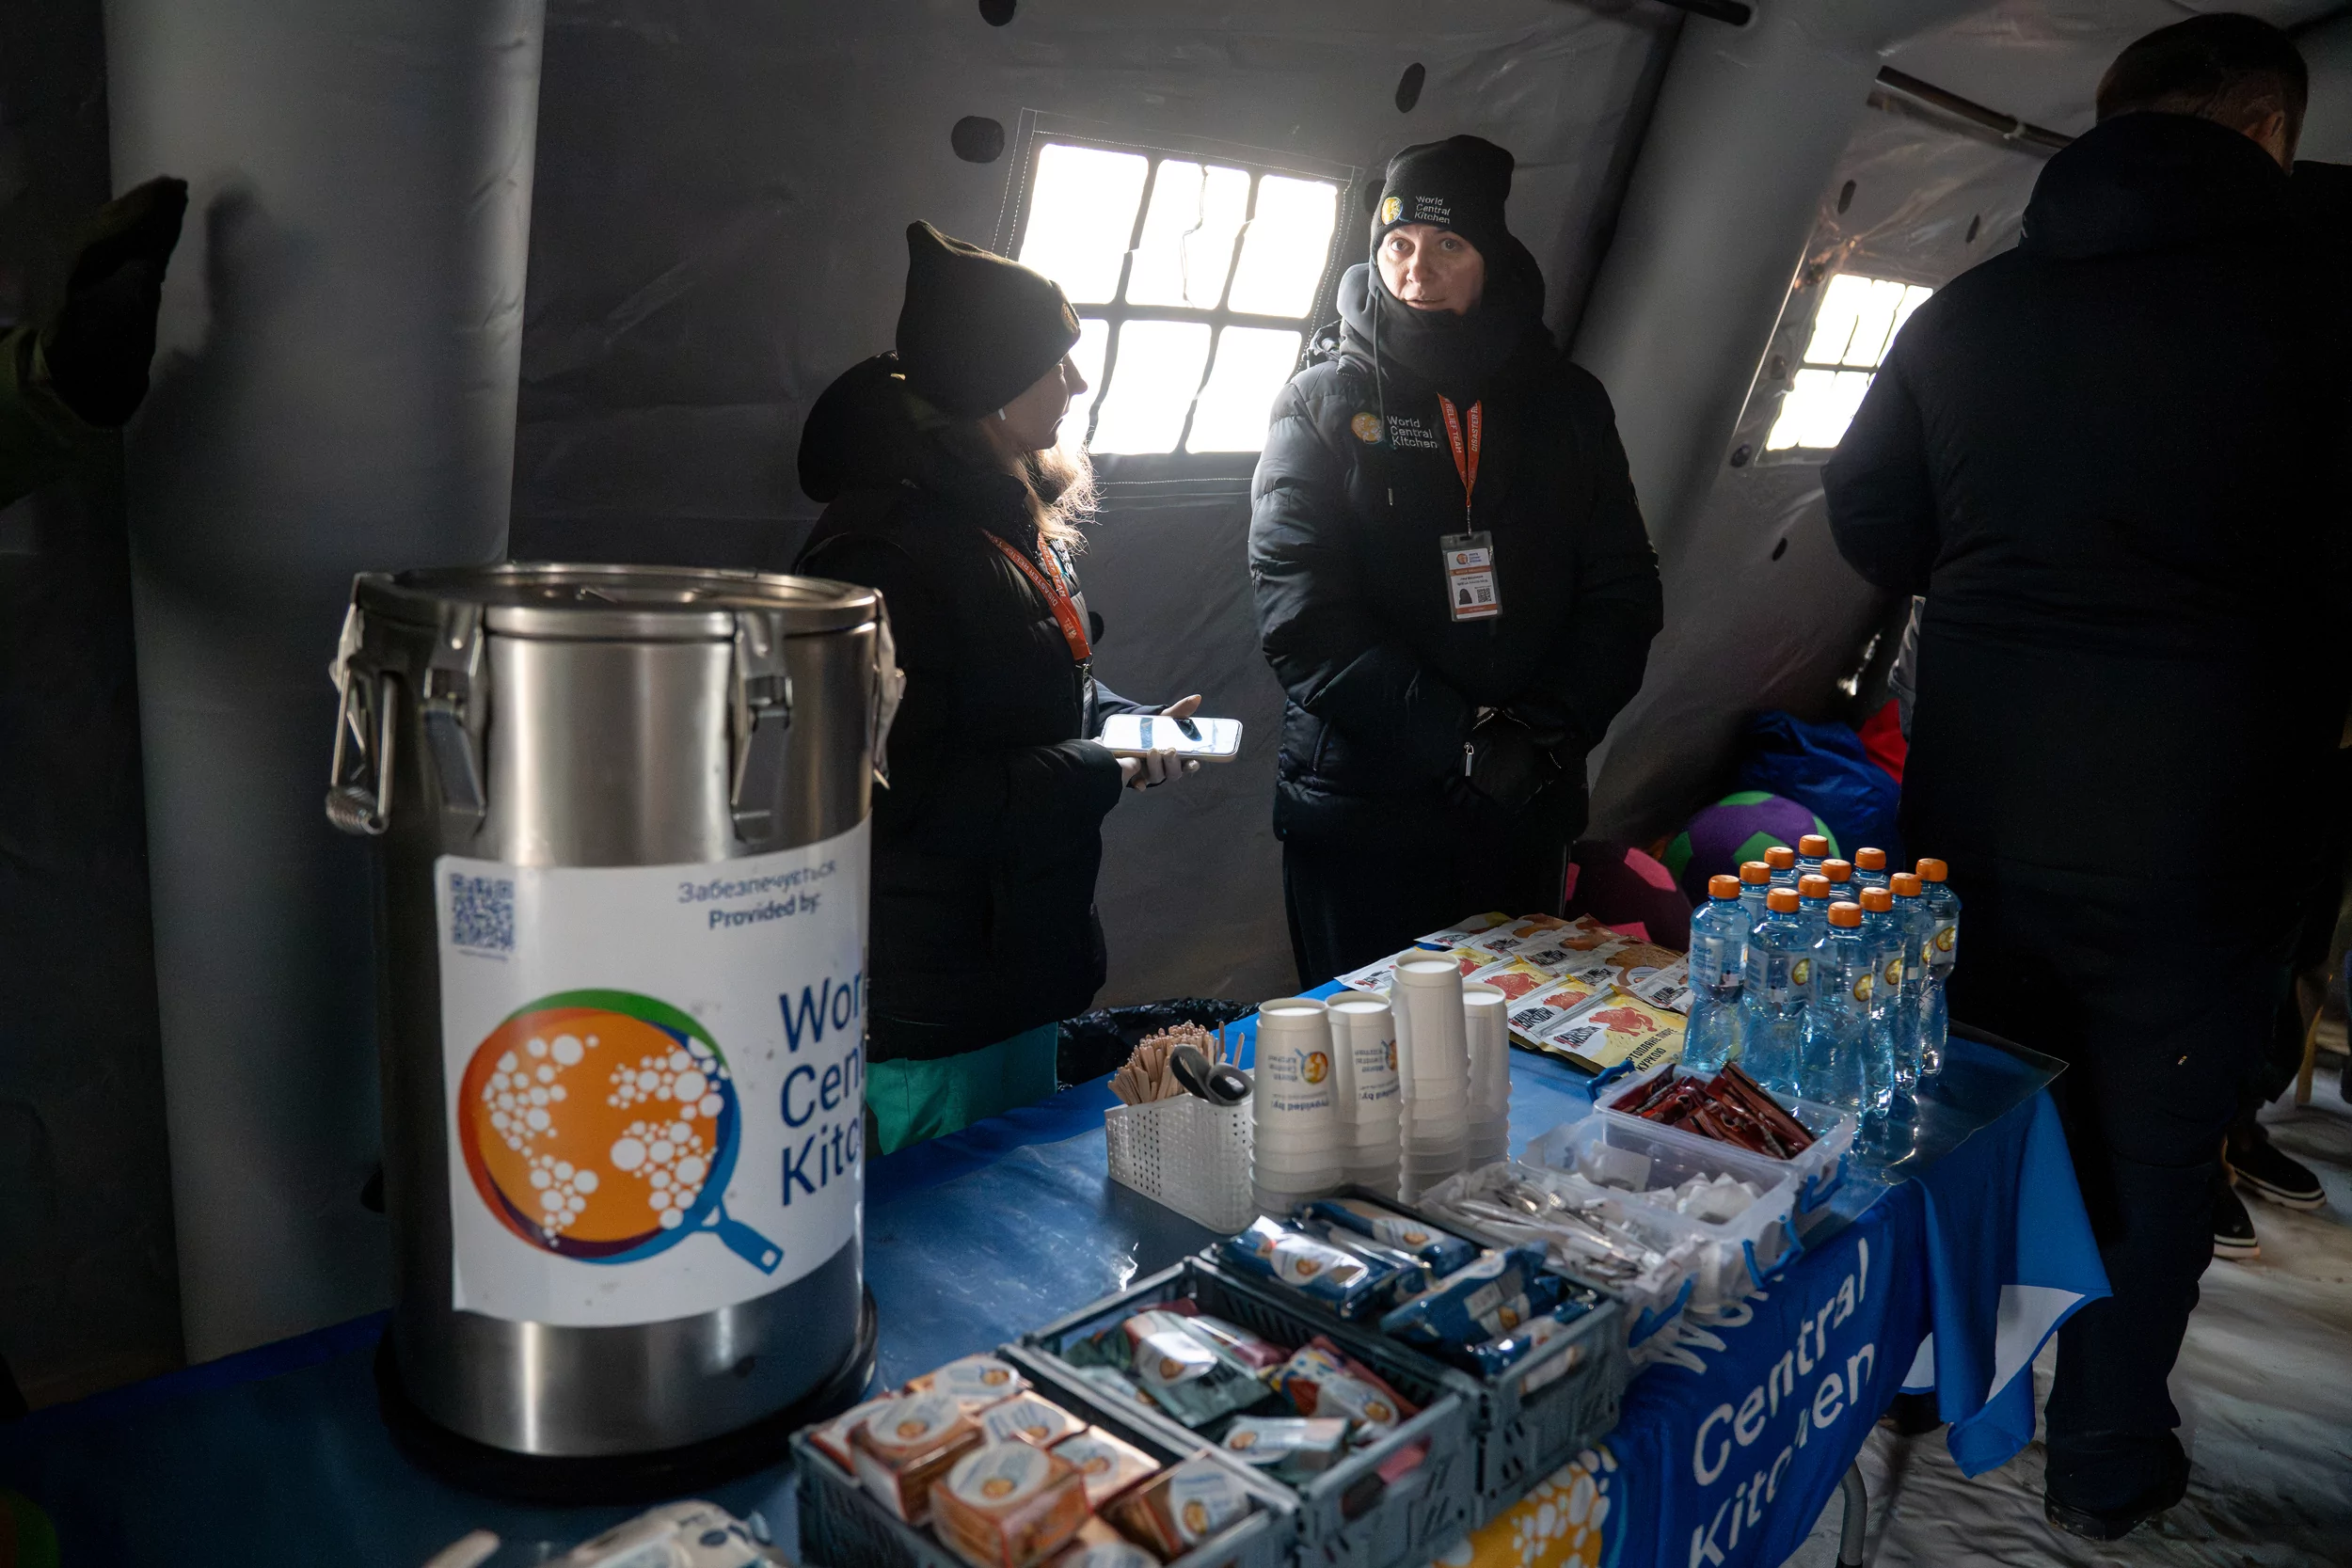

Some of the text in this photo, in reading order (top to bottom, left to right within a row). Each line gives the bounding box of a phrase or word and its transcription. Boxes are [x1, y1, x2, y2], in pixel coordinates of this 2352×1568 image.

[1414, 211, 1451, 225] Kitchen
[1415, 196, 1444, 206] World
[1416, 203, 1451, 216] Central
[1386, 415, 1421, 428] World
[1390, 425, 1433, 439] Central
[1445, 404, 1462, 453] RELIEF TEAM
[1470, 415, 1479, 452] DISASTER
[1391, 436, 1438, 449] Kitchen
[1003, 547, 1030, 573] RELIEF
[1041, 545, 1057, 572] RELIEF
[1054, 575, 1067, 598] TEAM
[1029, 570, 1058, 607] DISASTER
[708, 893, 796, 930] Provided
[778, 972, 864, 1053] Wor
[1635, 1047, 1667, 1072] КУРКОЮ
[780, 1039, 864, 1128] Cen
[782, 1117, 862, 1207] Kitc
[1692, 1237, 1868, 1486] Central
